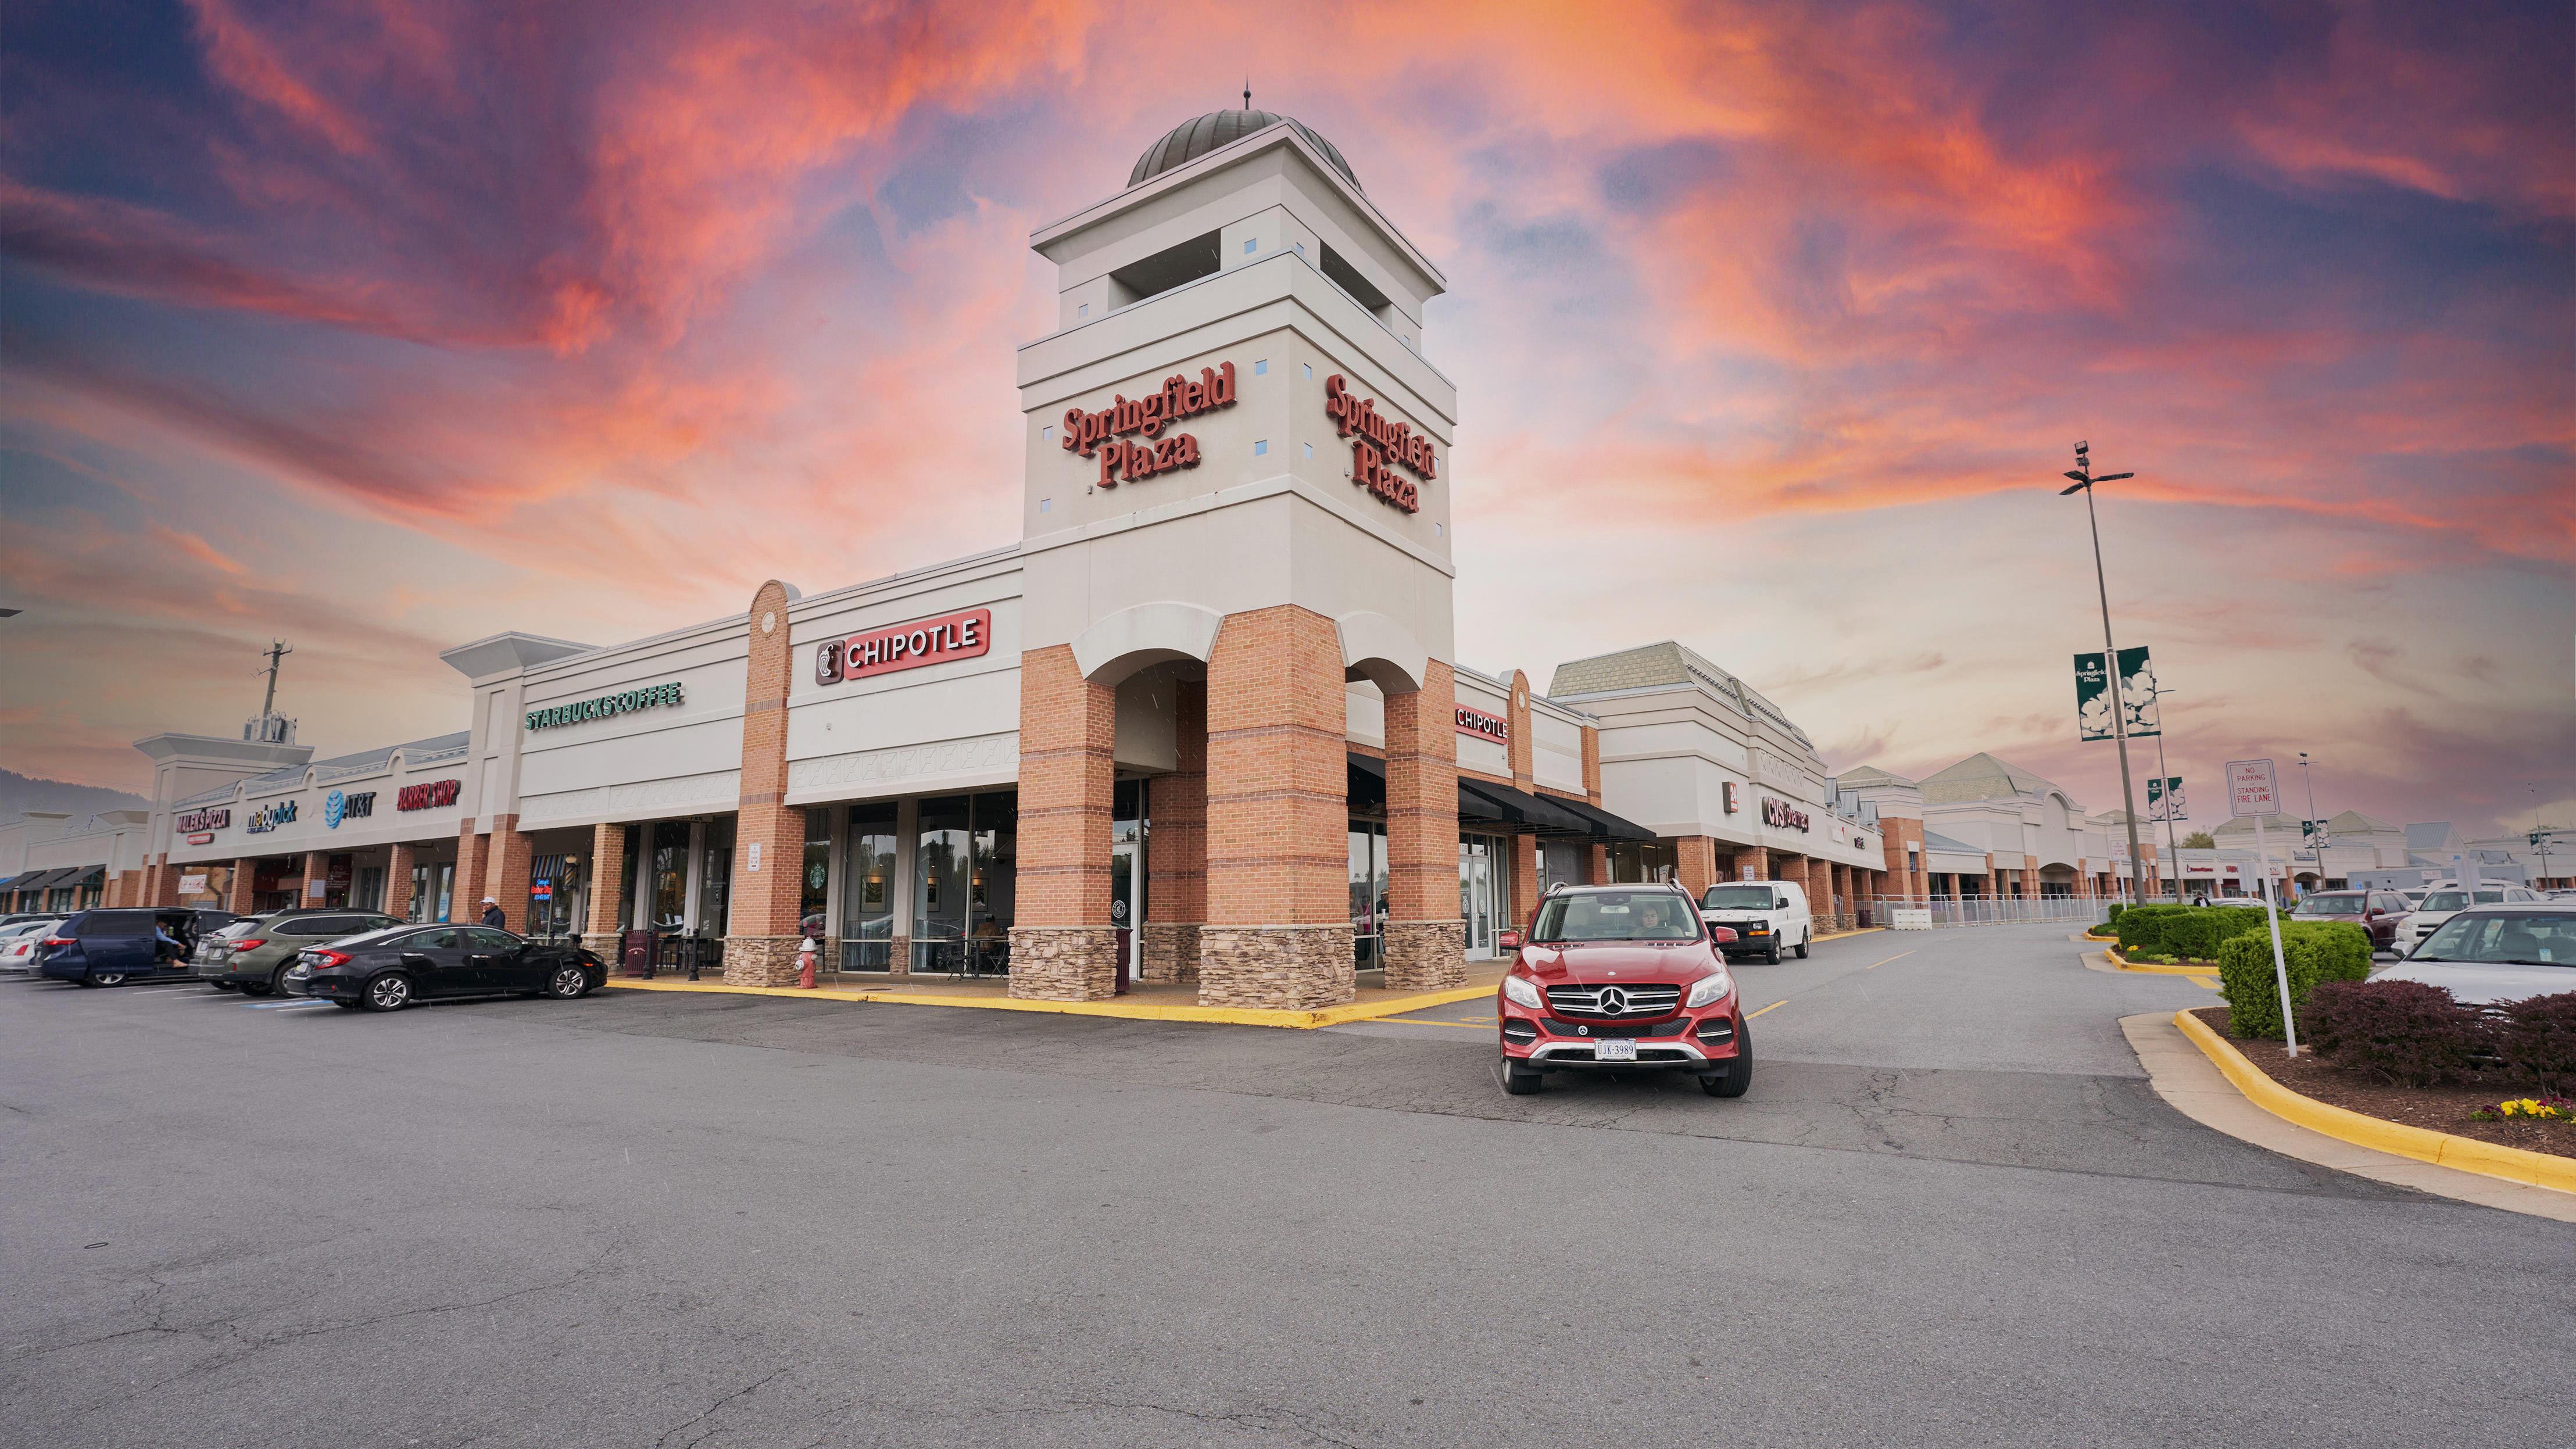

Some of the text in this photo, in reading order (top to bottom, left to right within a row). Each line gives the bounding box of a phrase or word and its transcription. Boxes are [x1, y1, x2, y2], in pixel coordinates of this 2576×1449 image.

[1062, 360, 1237, 458] Springfield
[1326, 373, 1436, 481] Springfield
[1097, 432, 1201, 489] Plaza
[1352, 439, 1419, 514] Plaza
[846, 618, 981, 669] CHIPOTLE
[524, 682, 682, 731] STARBUCKS COFFEE
[1456, 708, 1508, 739] CHIPOTLE
[343, 792, 377, 819] AT&T
[397, 779, 461, 813] BARBER SHOP
[2237, 786, 2269, 795] STANDING
[2237, 794, 2271, 803] FIRE LANE
[205, 808, 230, 829] PIZZA
